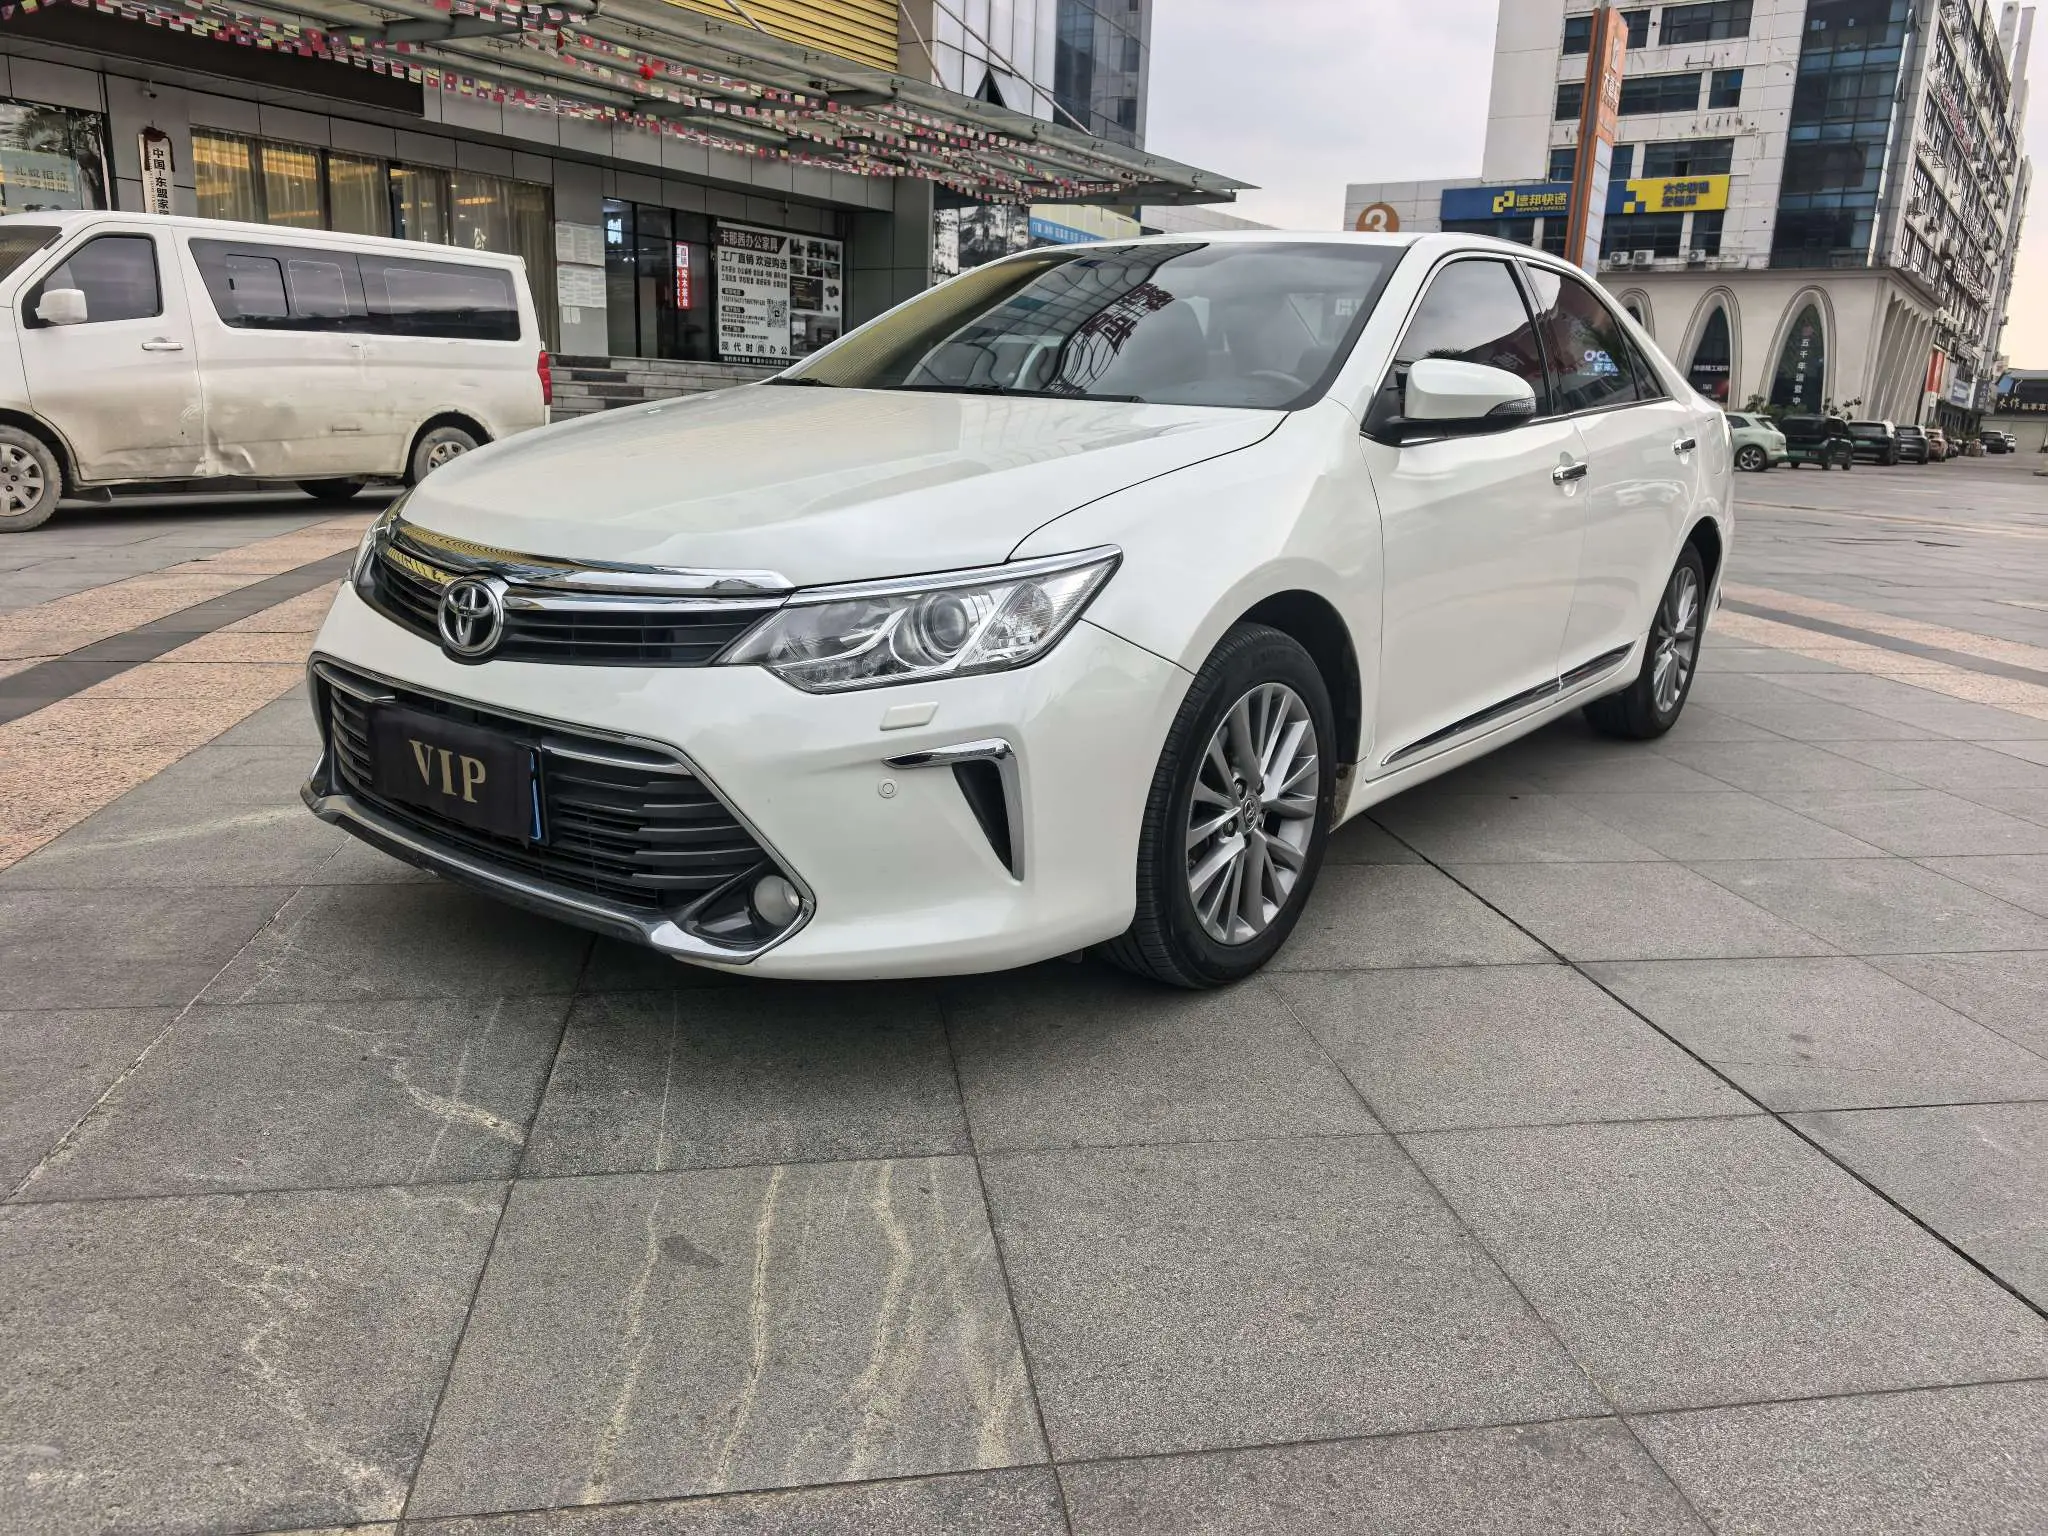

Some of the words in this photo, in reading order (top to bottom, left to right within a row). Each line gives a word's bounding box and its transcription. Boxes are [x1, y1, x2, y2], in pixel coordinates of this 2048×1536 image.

[1516, 192, 1567, 207] 德邦快递
[408, 739, 486, 804] VIP
